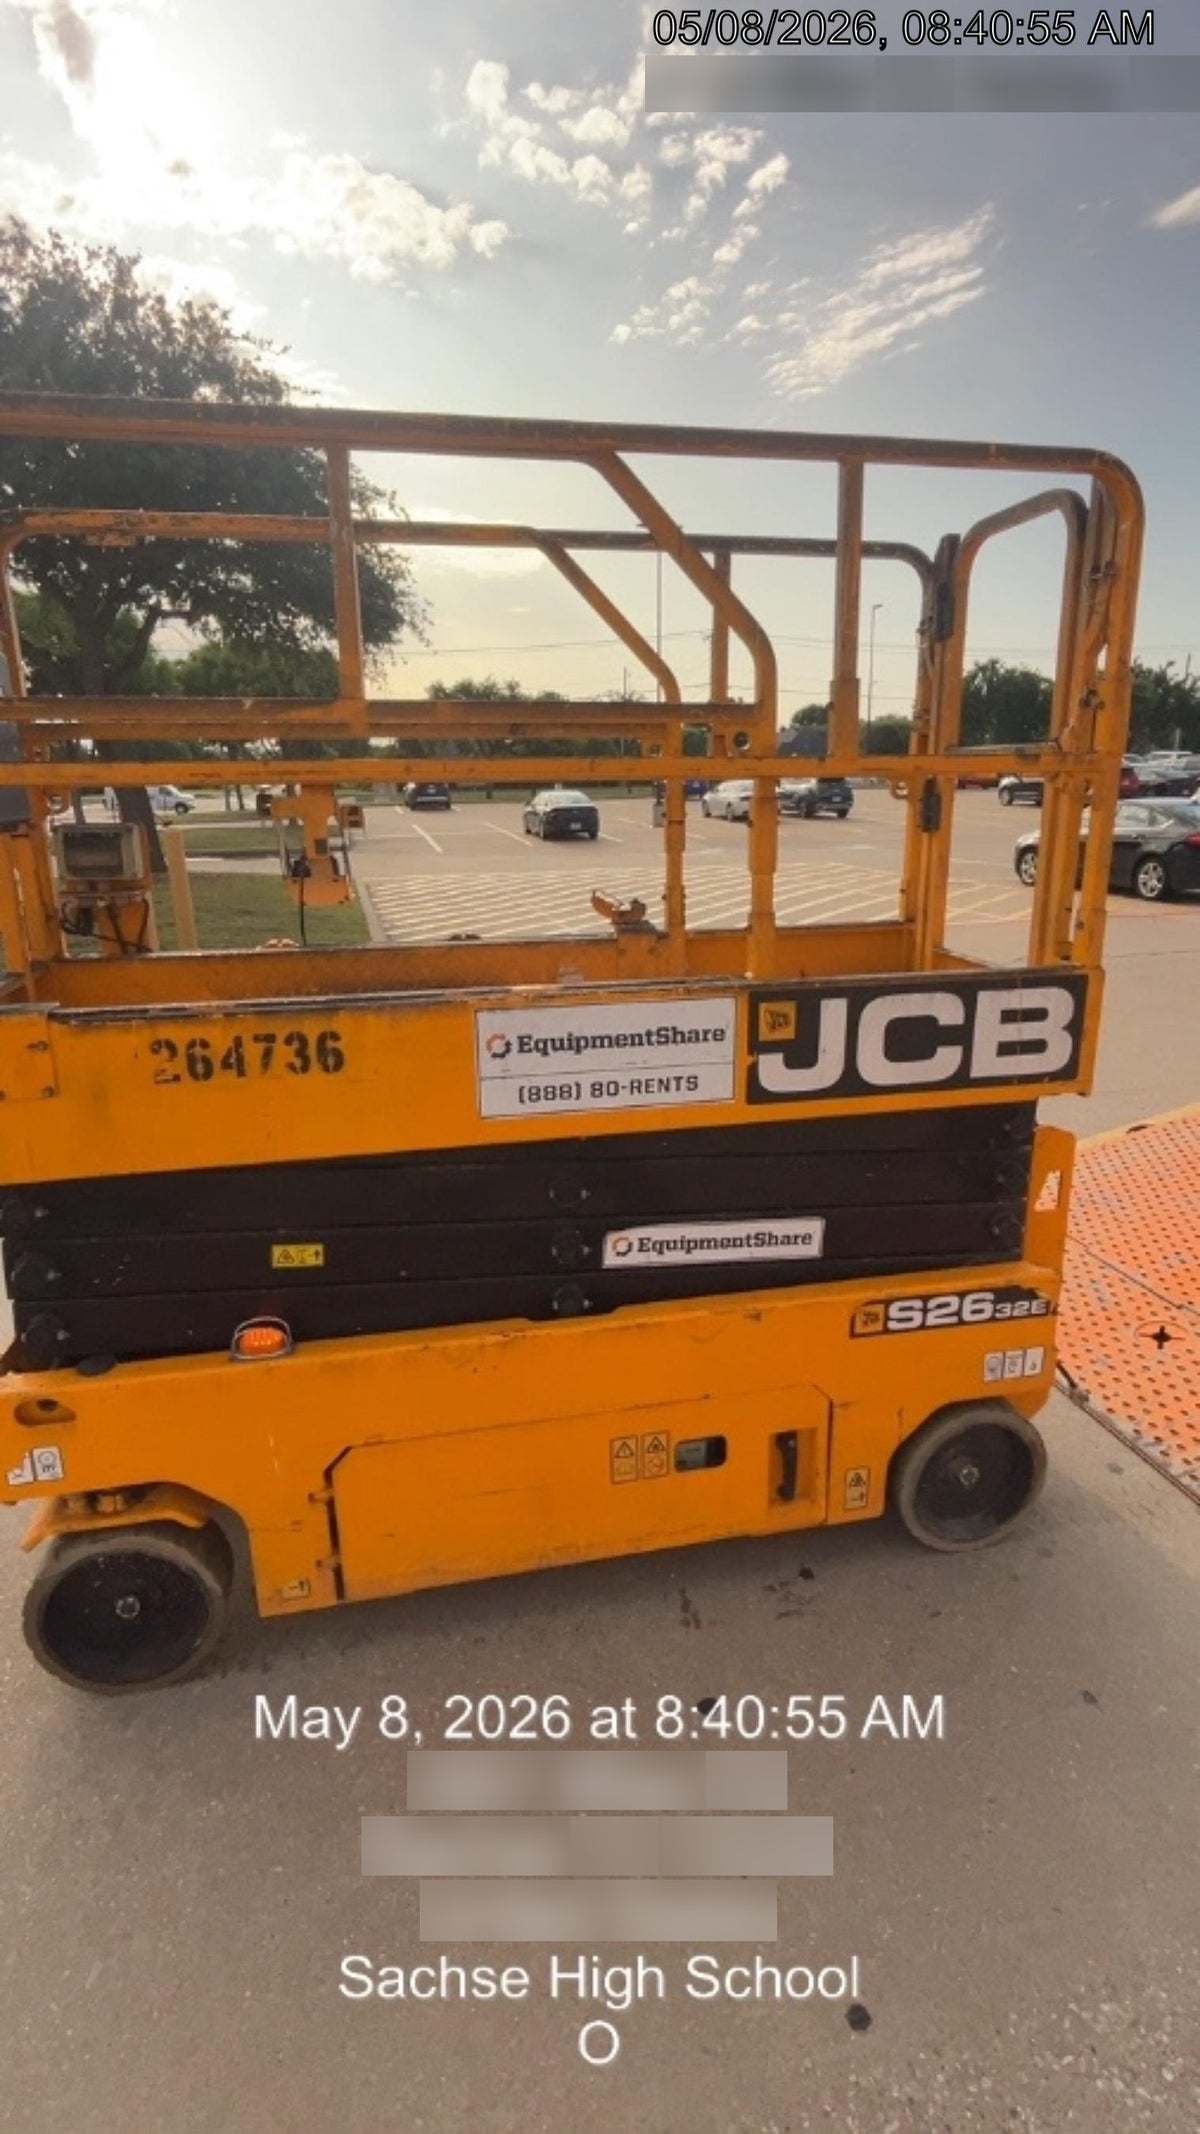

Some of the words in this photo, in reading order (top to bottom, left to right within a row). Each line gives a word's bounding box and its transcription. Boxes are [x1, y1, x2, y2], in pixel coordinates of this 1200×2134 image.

[516, 1025, 727, 1058] EquipmentShare
[757, 986, 1075, 1093] JCB
[150, 1031, 346, 1085] 264736
[518, 1082, 582, 1104] (888)
[590, 1075, 699, 1100] 80-RENTS
[636, 1230, 814, 1254] EquipmentShare
